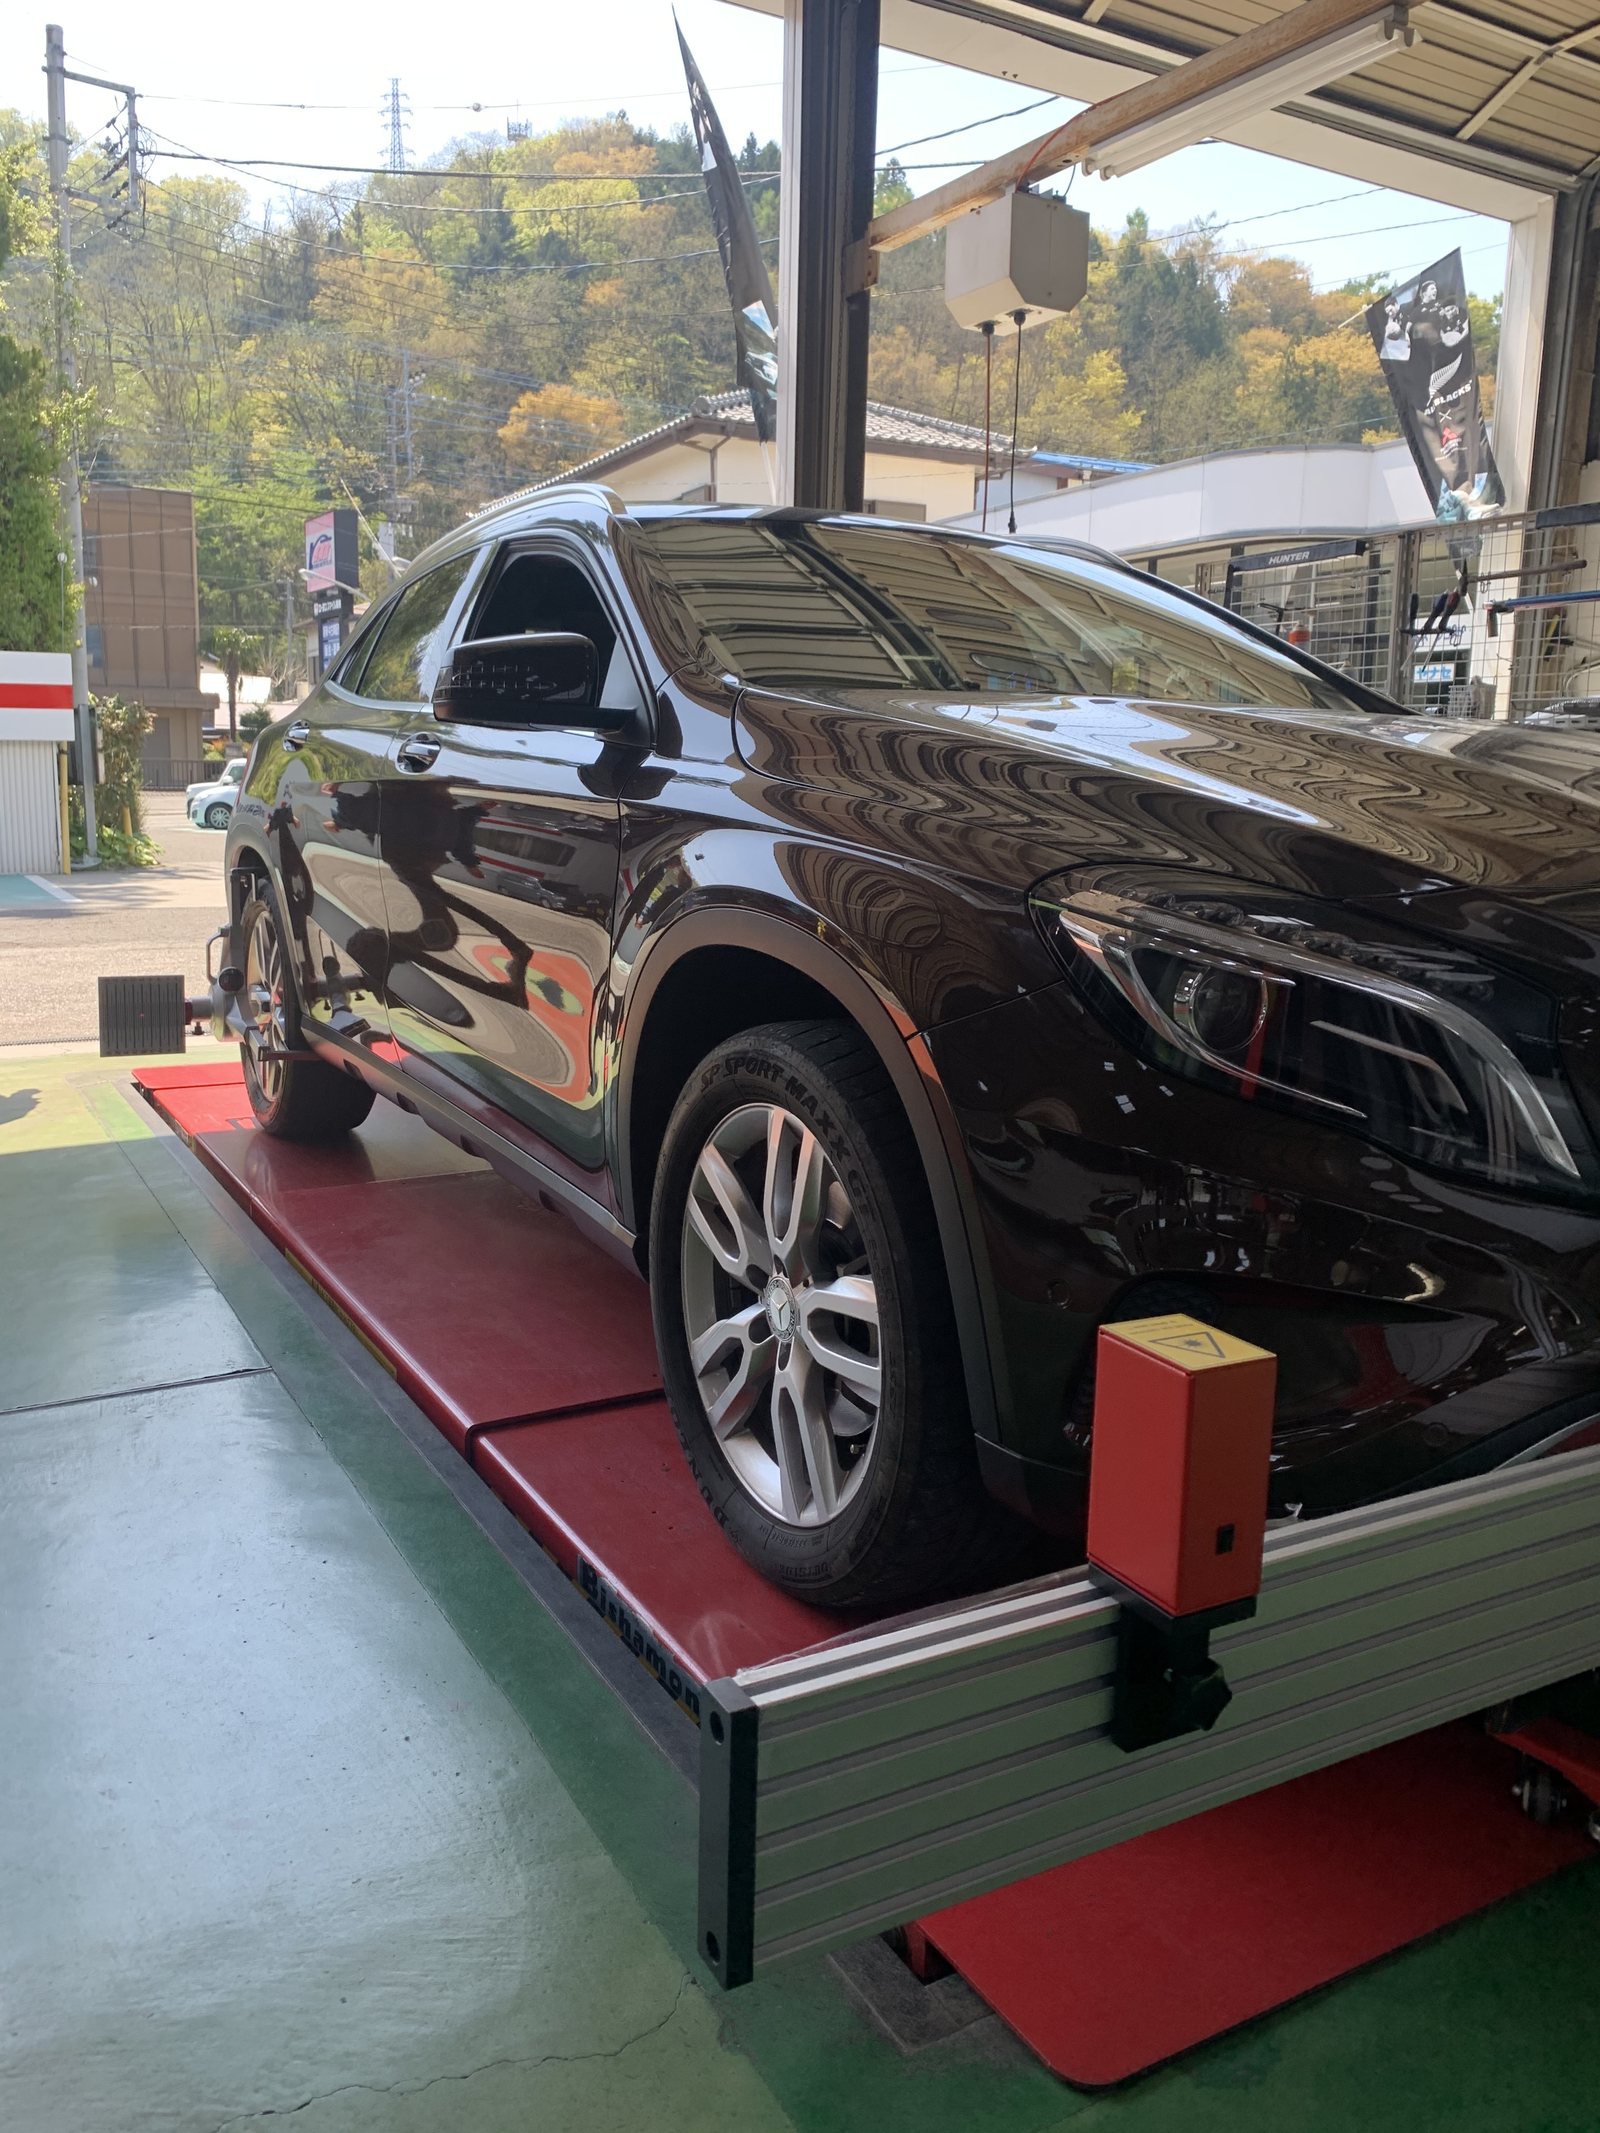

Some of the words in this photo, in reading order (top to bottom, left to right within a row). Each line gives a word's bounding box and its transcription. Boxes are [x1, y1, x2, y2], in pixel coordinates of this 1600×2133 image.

[1433, 383, 1472, 406] BLACKS
[1268, 550, 1310, 566] HUNTER
[700, 1063, 721, 1093] SP
[723, 1056, 786, 1084] SPORT
[784, 1075, 850, 1163] MAXX
